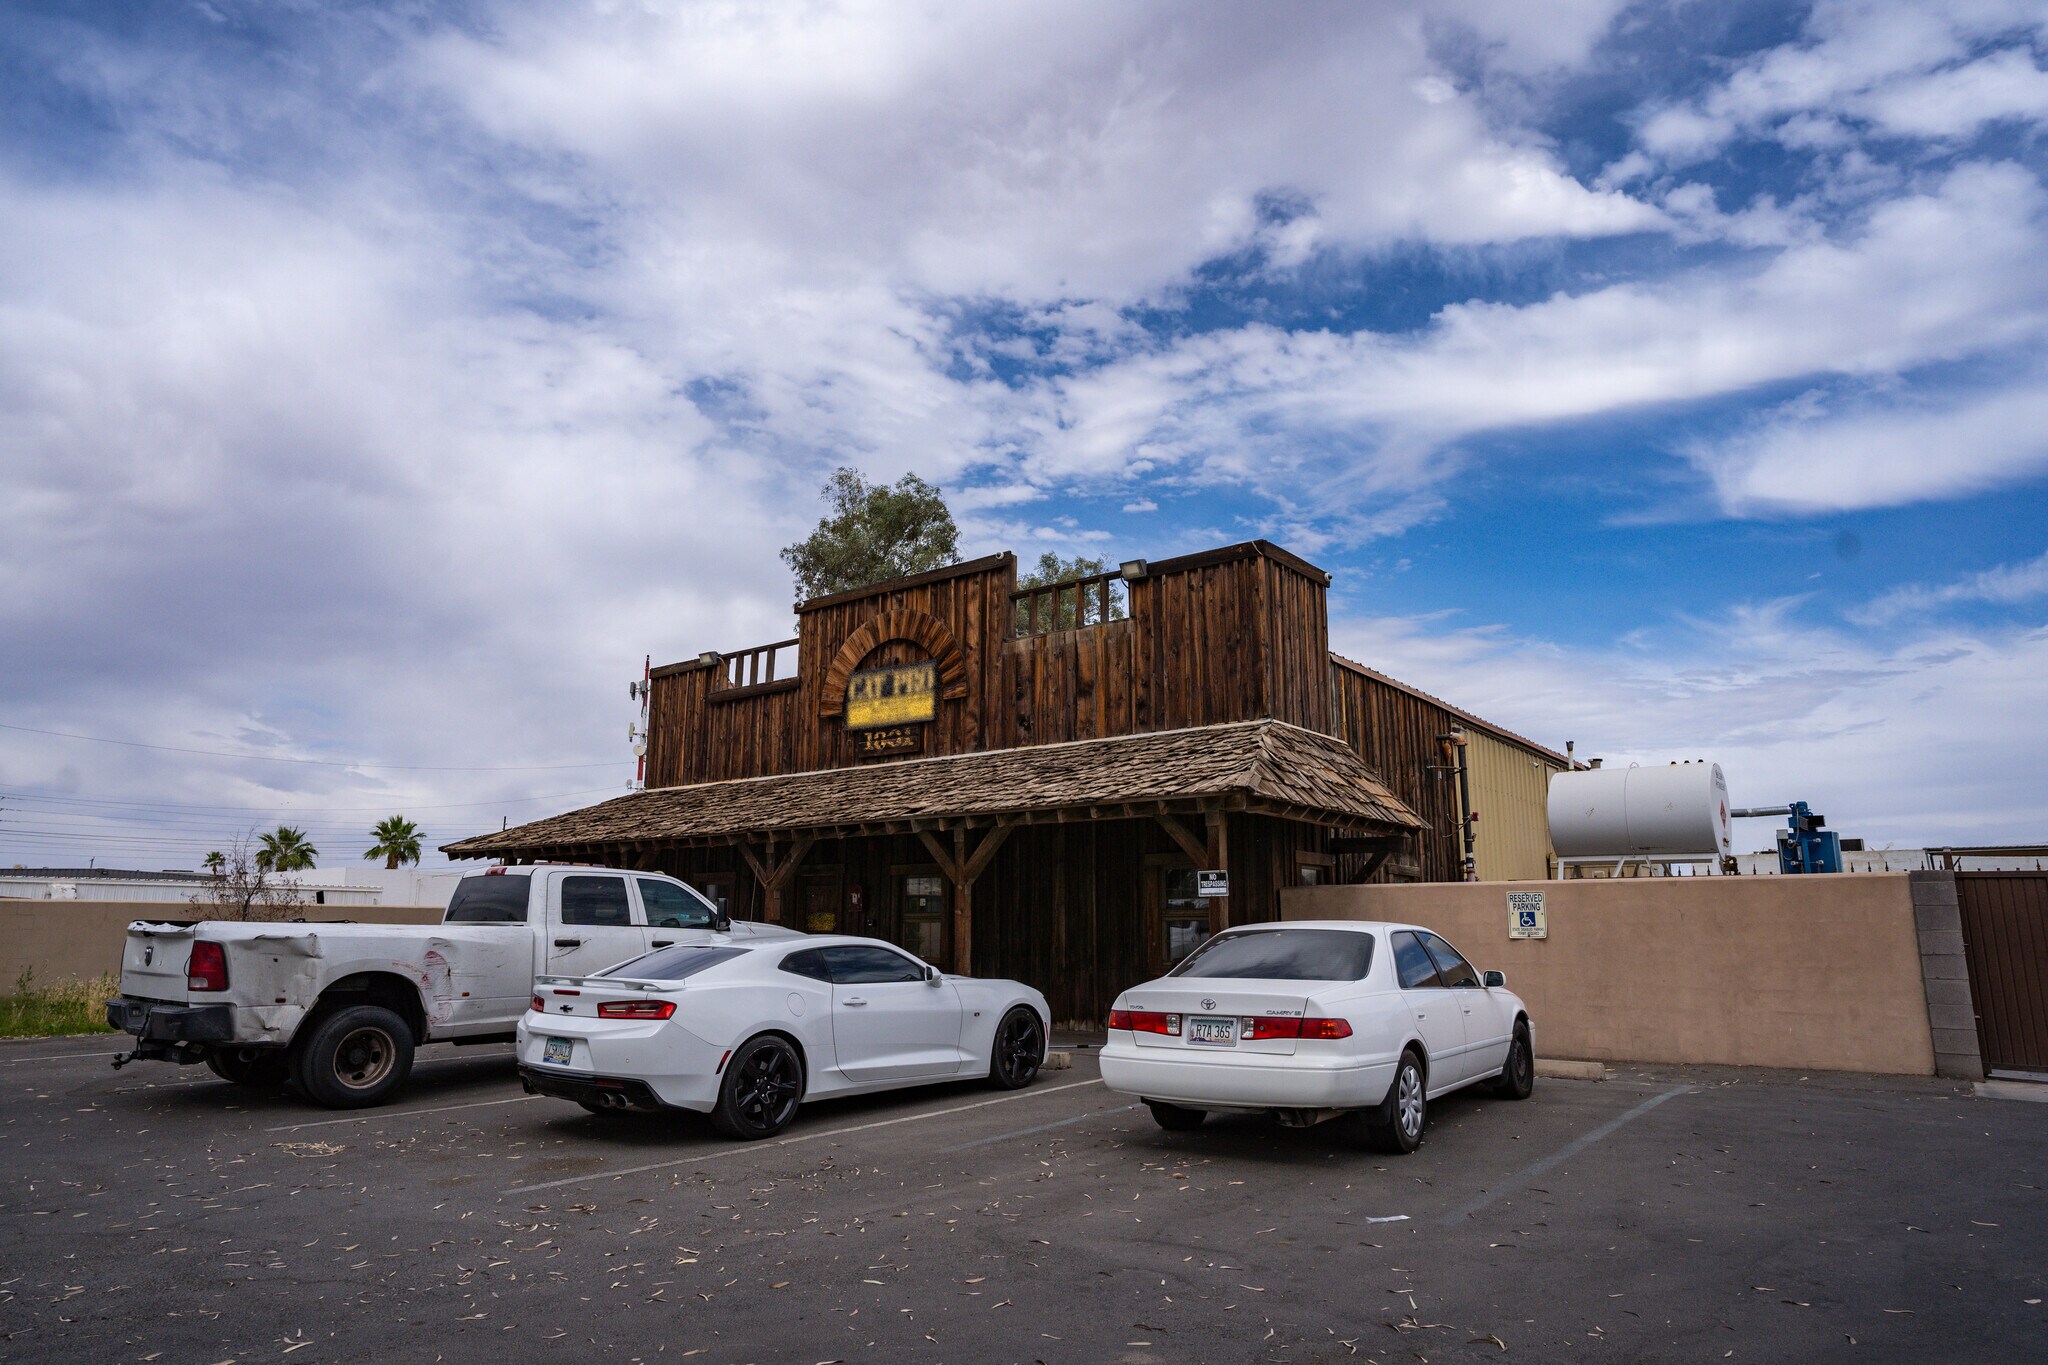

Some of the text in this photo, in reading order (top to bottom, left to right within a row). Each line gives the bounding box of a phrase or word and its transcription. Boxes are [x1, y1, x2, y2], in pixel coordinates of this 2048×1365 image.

[1201, 880, 1227, 888] TRESPASSING
[1510, 894, 1542, 902] RESERVED
[1513, 902, 1541, 911] PARKING
